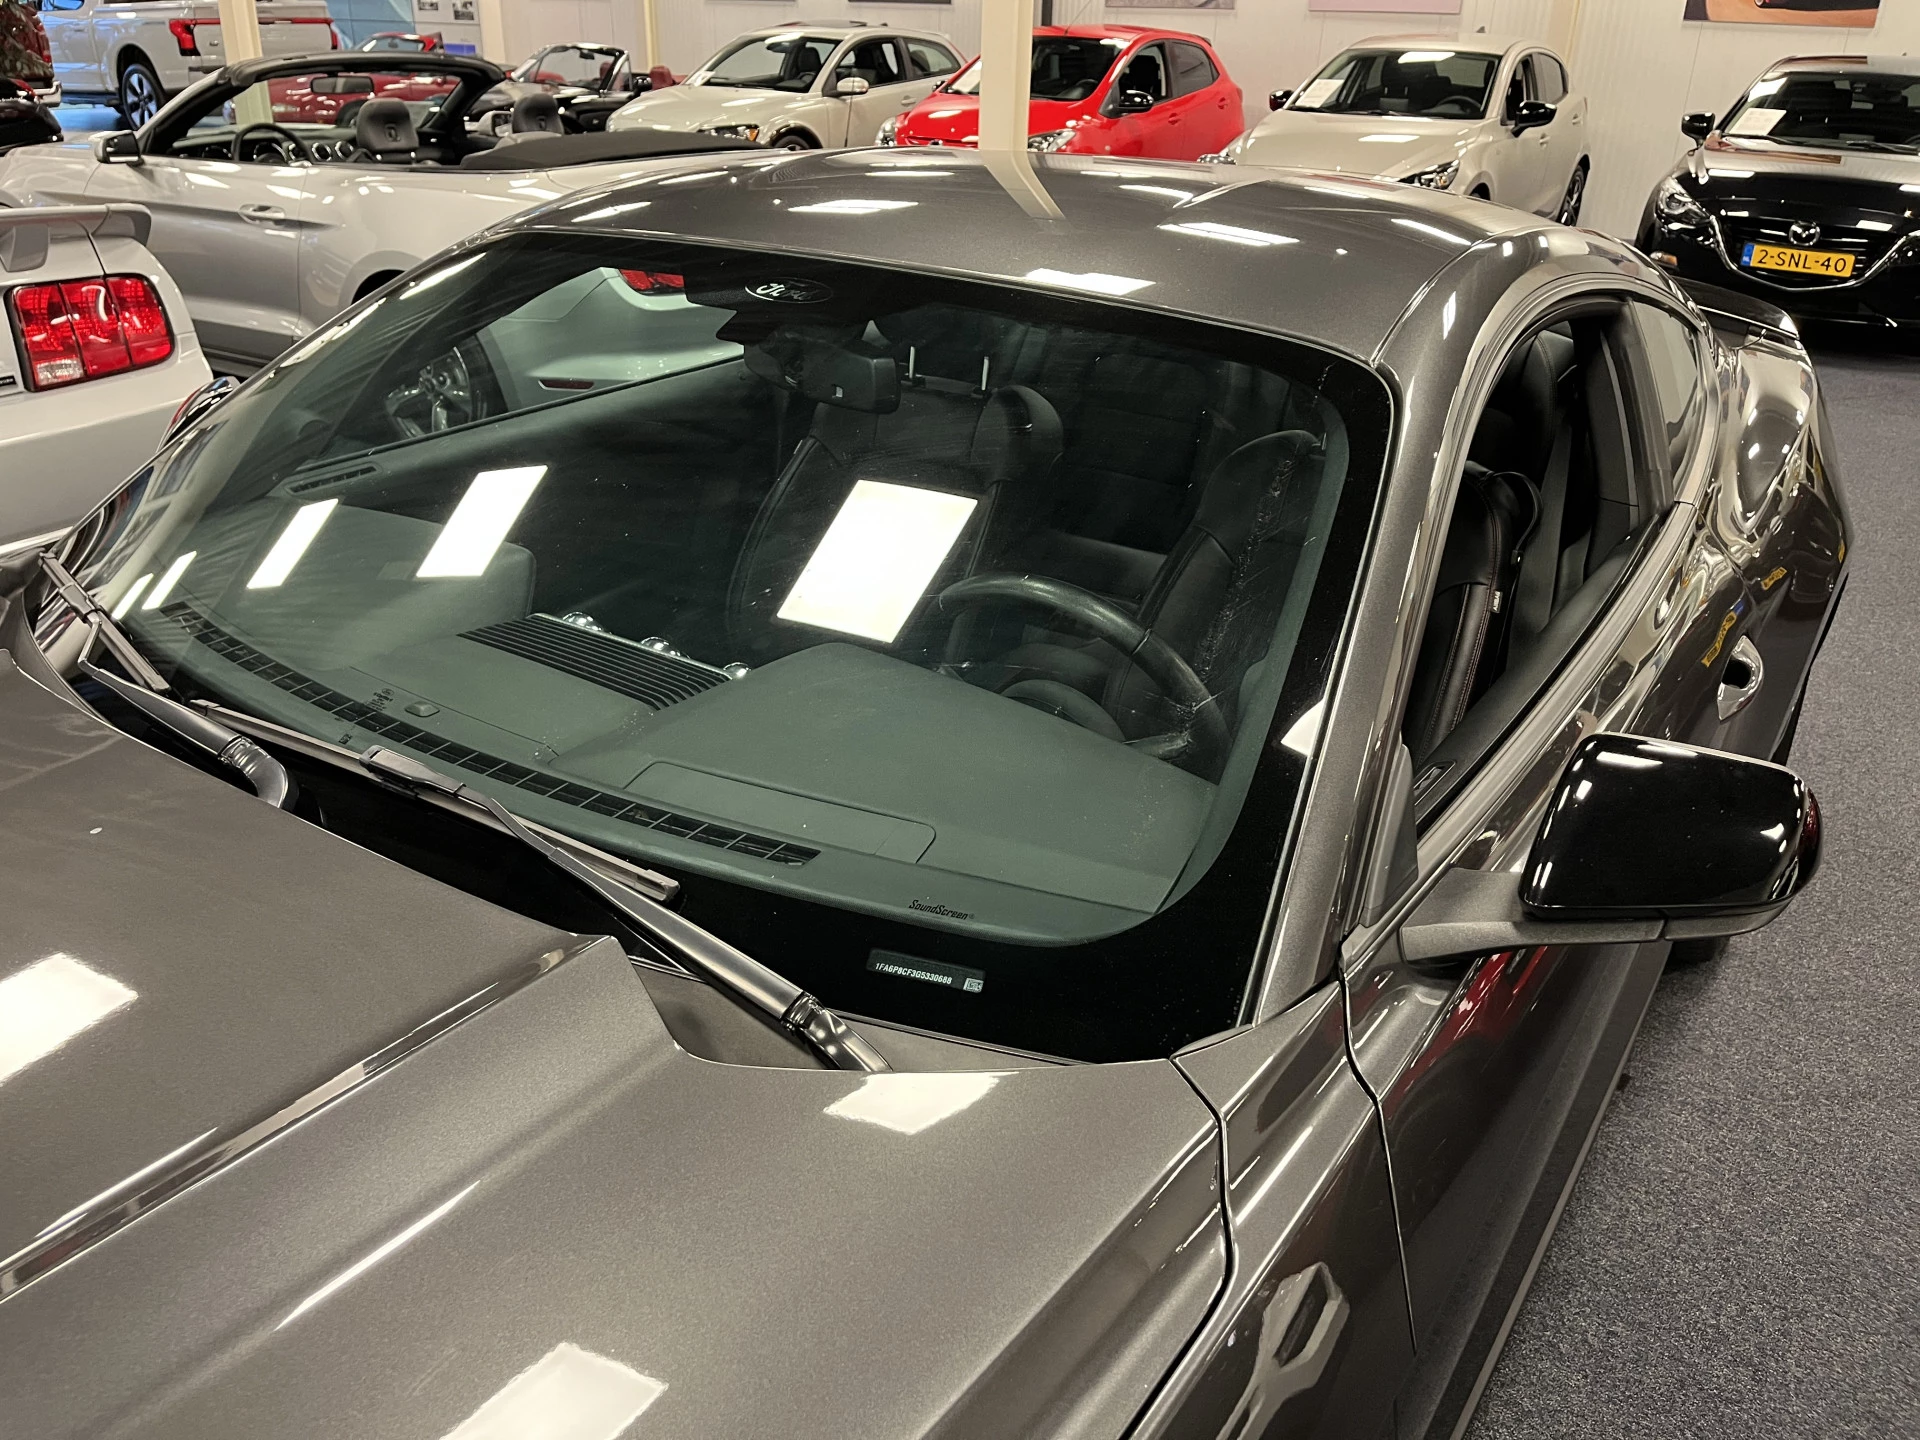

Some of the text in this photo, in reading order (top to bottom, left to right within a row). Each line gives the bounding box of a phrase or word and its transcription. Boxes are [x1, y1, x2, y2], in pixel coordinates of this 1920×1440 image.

[1757, 249, 1847, 273] 2-SNL-40
[908, 899, 969, 920] SoundScreen
[875, 962, 953, 985] 1FA6P8CF3G5330688
